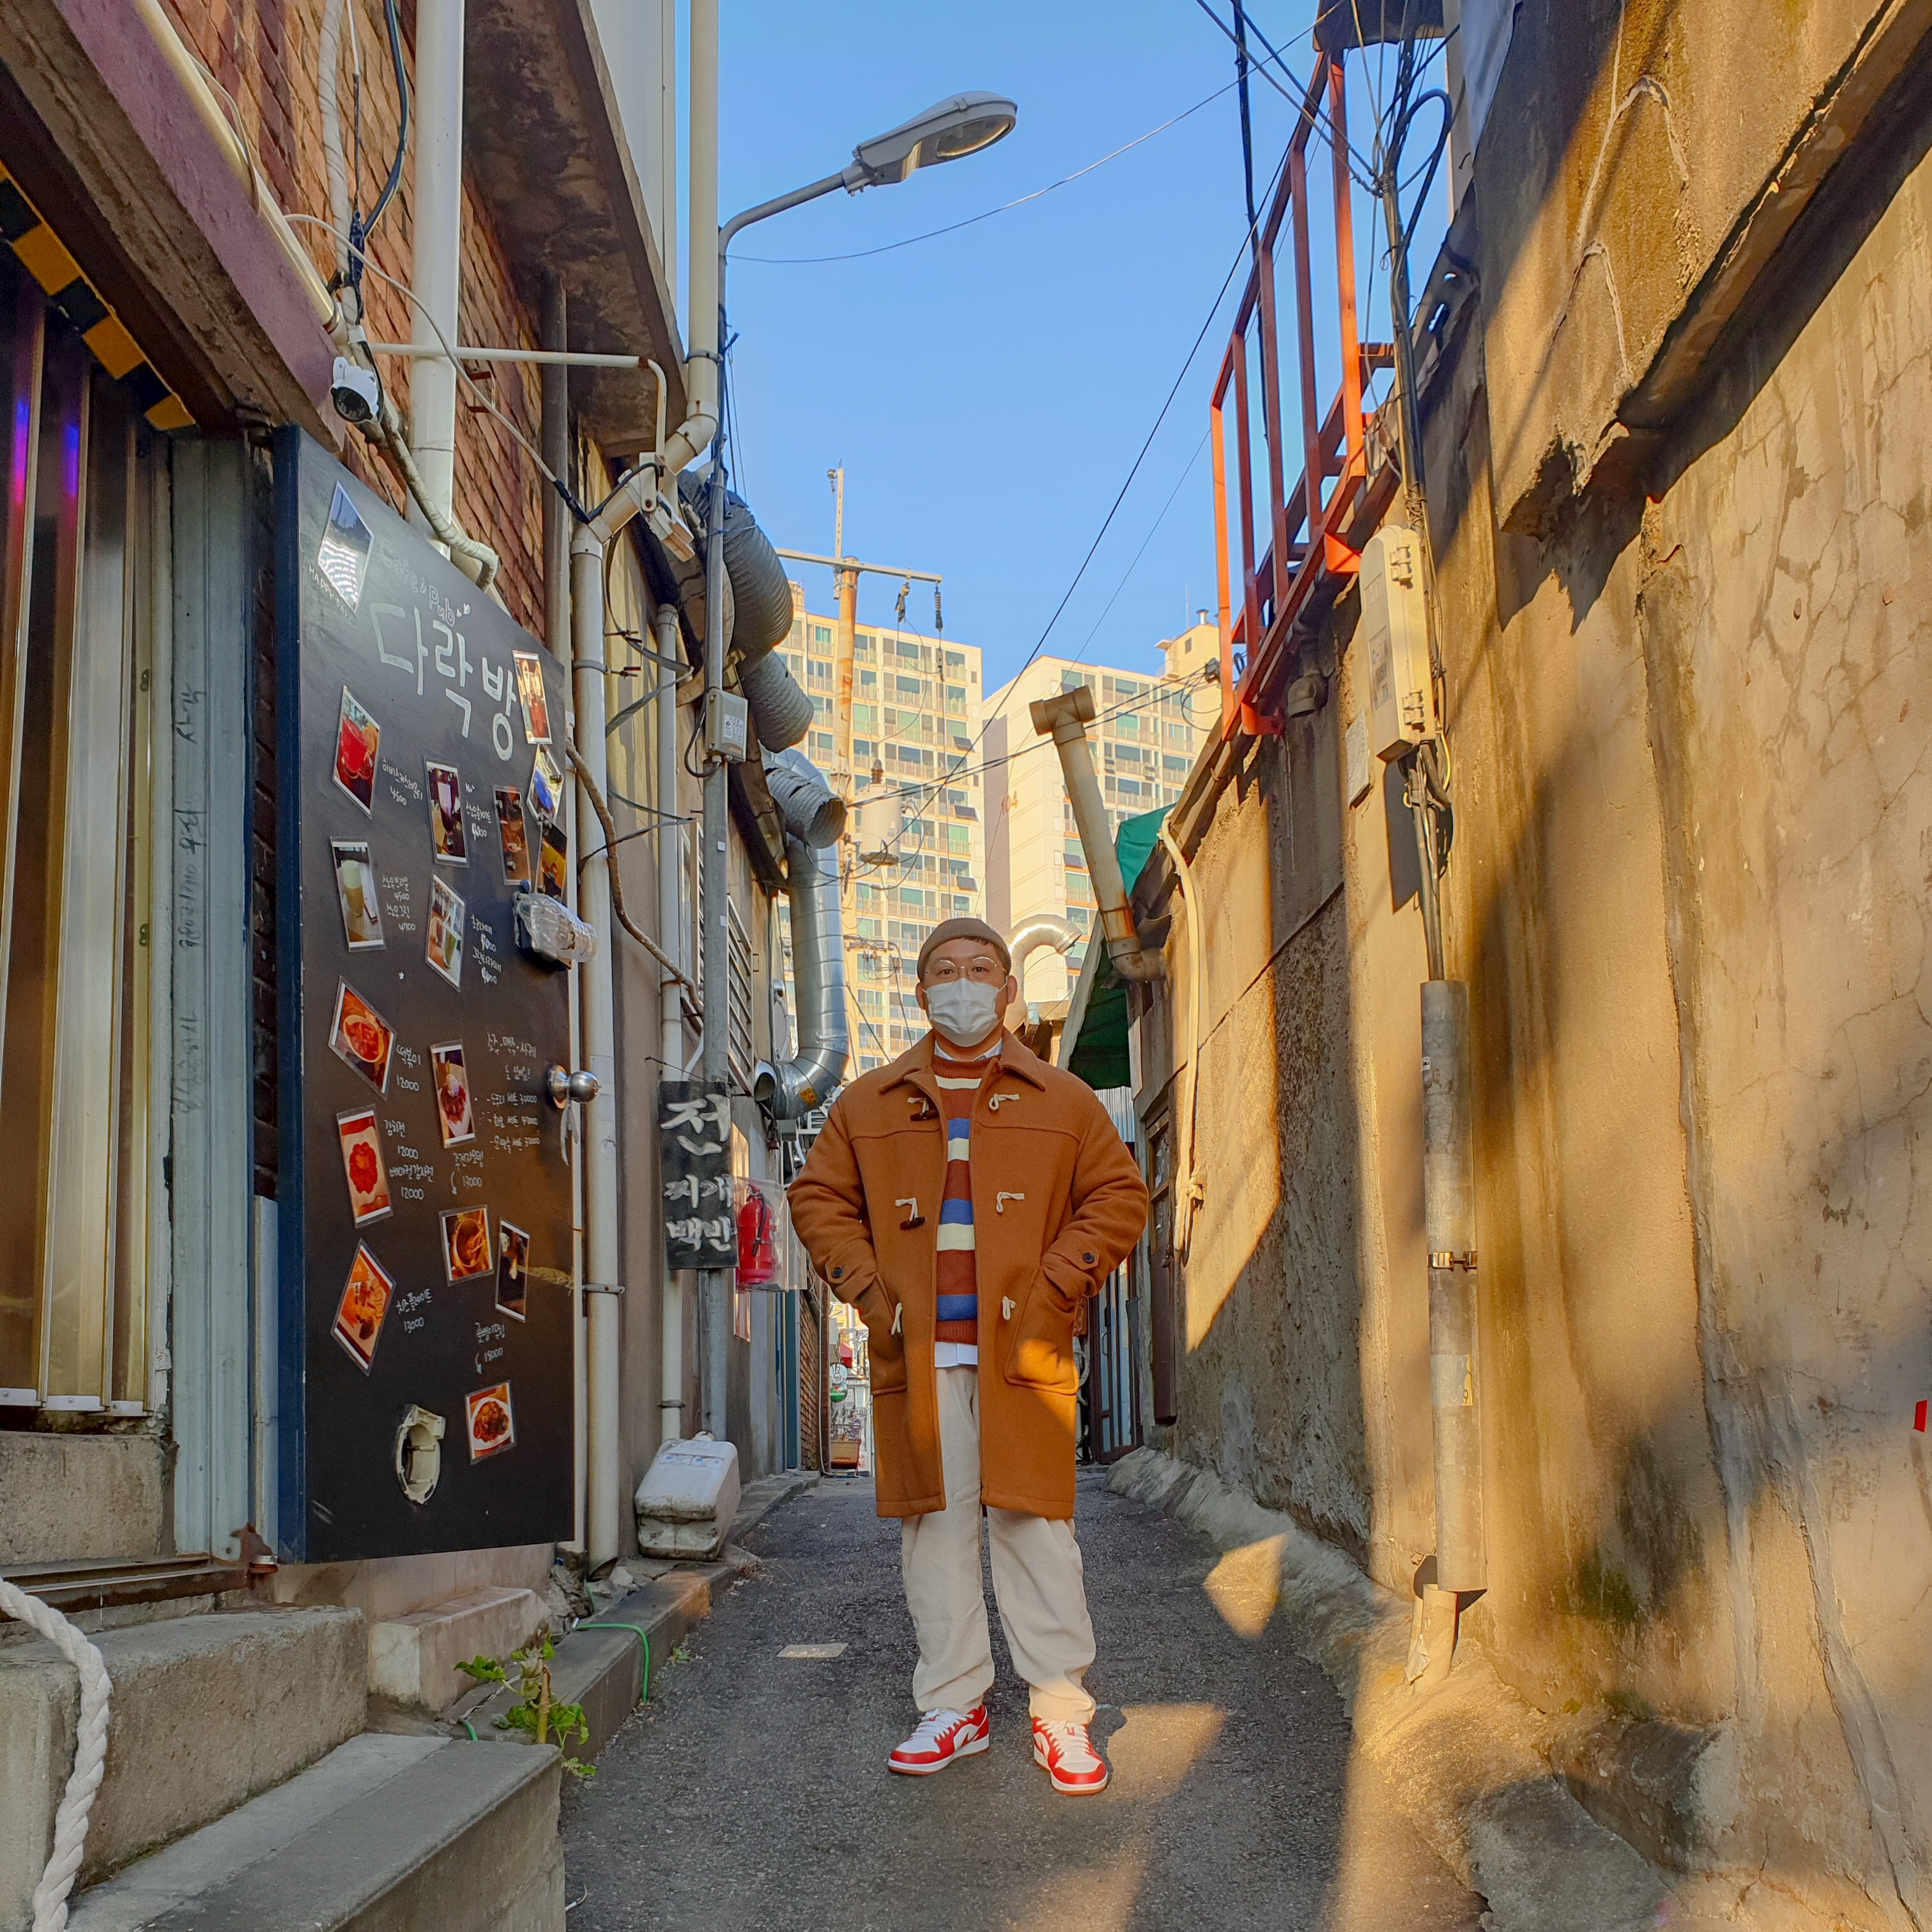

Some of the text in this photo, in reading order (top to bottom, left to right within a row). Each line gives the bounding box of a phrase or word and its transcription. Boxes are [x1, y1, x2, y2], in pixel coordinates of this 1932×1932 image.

[308, 564, 334, 599] HAPPY
[429, 585, 456, 627] Pub
[369, 602, 517, 762] 다락방
[390, 785, 408, 806] 4500
[1000, 790, 1019, 816] 104
[394, 891, 410, 901] 4500
[398, 923, 416, 932] 4700
[396, 1045, 422, 1069] 떡볶이
[396, 1074, 420, 1091] 12000
[383, 1119, 406, 1138] 김치전
[659, 1092, 732, 1156] 전
[397, 1145, 419, 1160] 12000
[401, 1186, 424, 1200] 12000
[663, 1173, 733, 1209] 찌개
[665, 1215, 735, 1252] 백반
